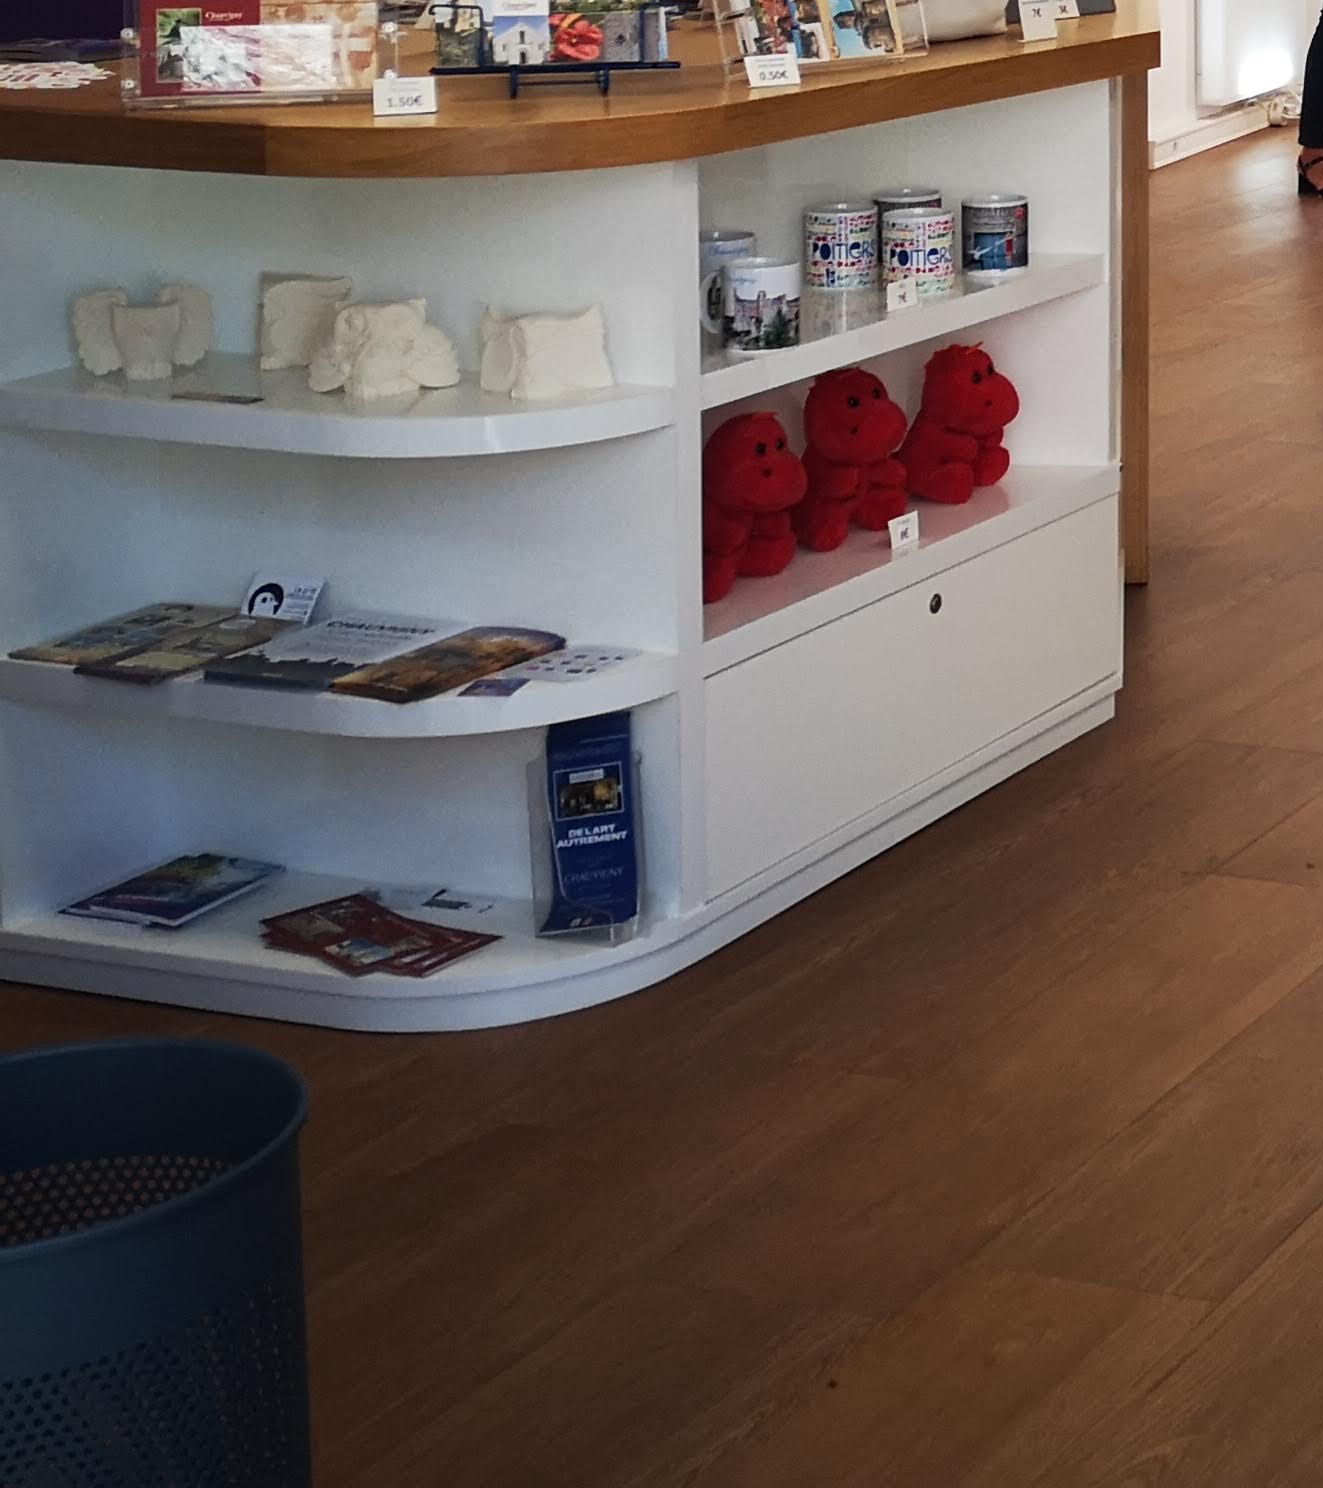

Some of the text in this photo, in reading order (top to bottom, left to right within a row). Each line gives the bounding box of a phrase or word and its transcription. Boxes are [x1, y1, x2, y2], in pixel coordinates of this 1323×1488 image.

[759, 70, 789, 82] 0.50€
[386, 94, 423, 109] 1.50€
[812, 238, 878, 261] POITIERS
[556, 829, 628, 849] AUTREMENT
